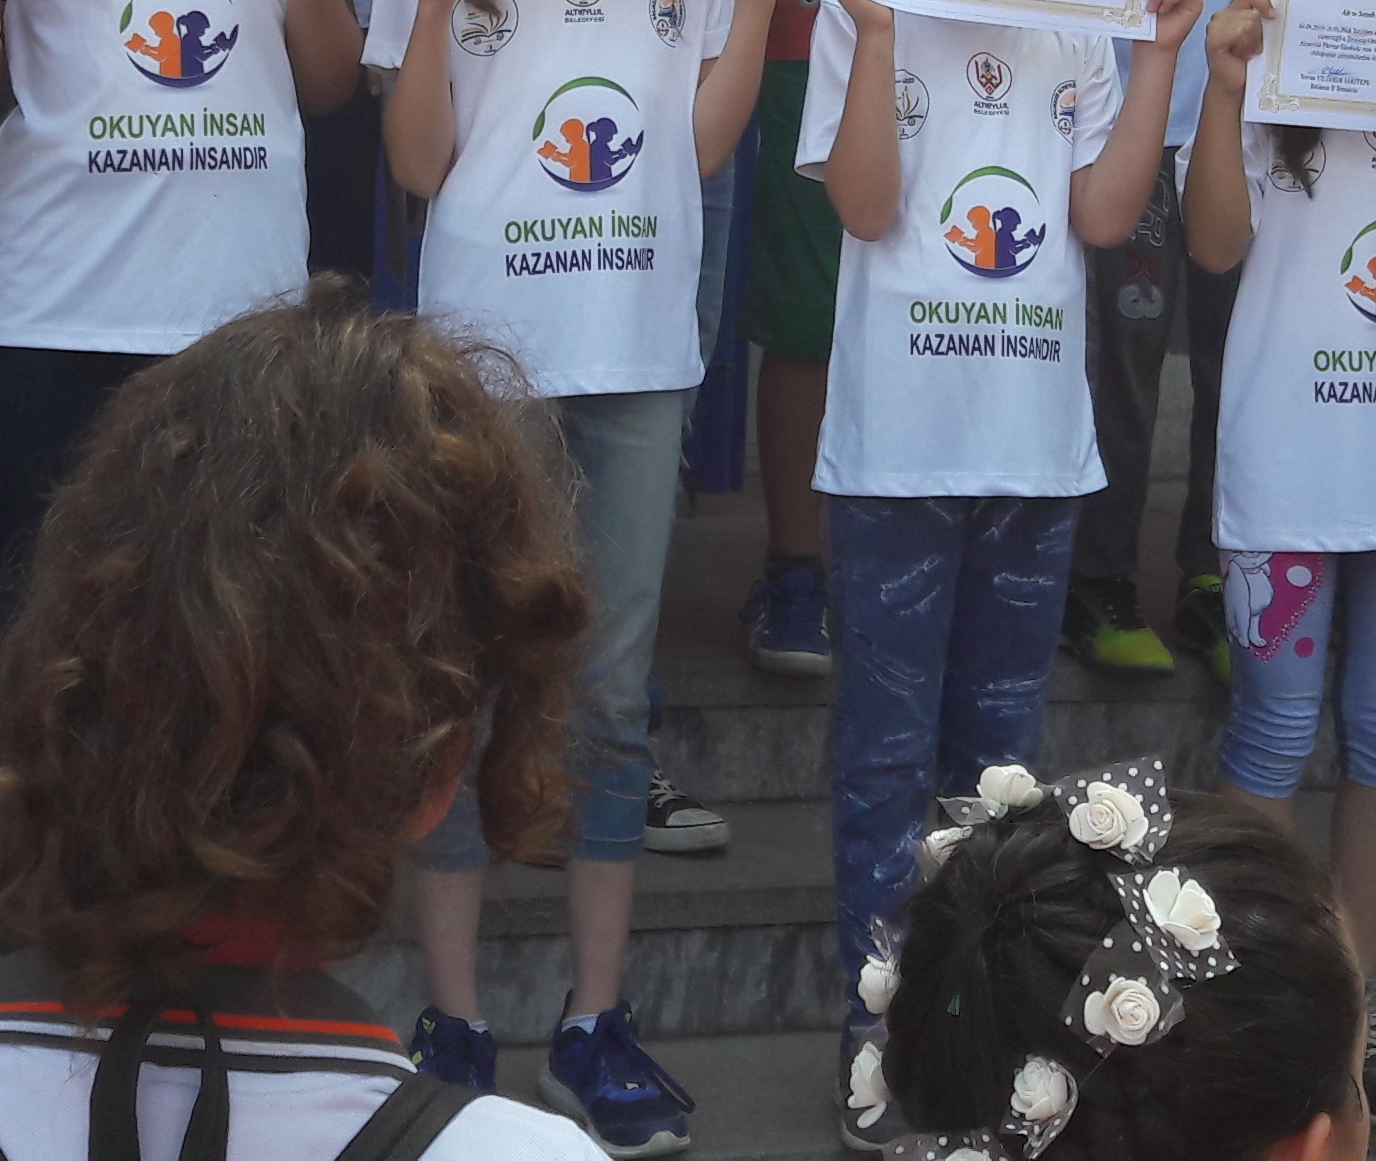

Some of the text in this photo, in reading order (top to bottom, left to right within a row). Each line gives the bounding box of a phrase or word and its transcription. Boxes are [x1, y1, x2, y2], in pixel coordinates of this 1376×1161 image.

[89, 107, 266, 140] OKUYAN İNSAN
[88, 142, 268, 173] KAZANAN İNSANDIR
[504, 209, 658, 244] OKUYAN İNSAN
[505, 250, 592, 277] KAZANAN
[910, 297, 1064, 331] OKUYAN İNSAN
[910, 329, 1061, 363] KAZANAN İNSANDIR
